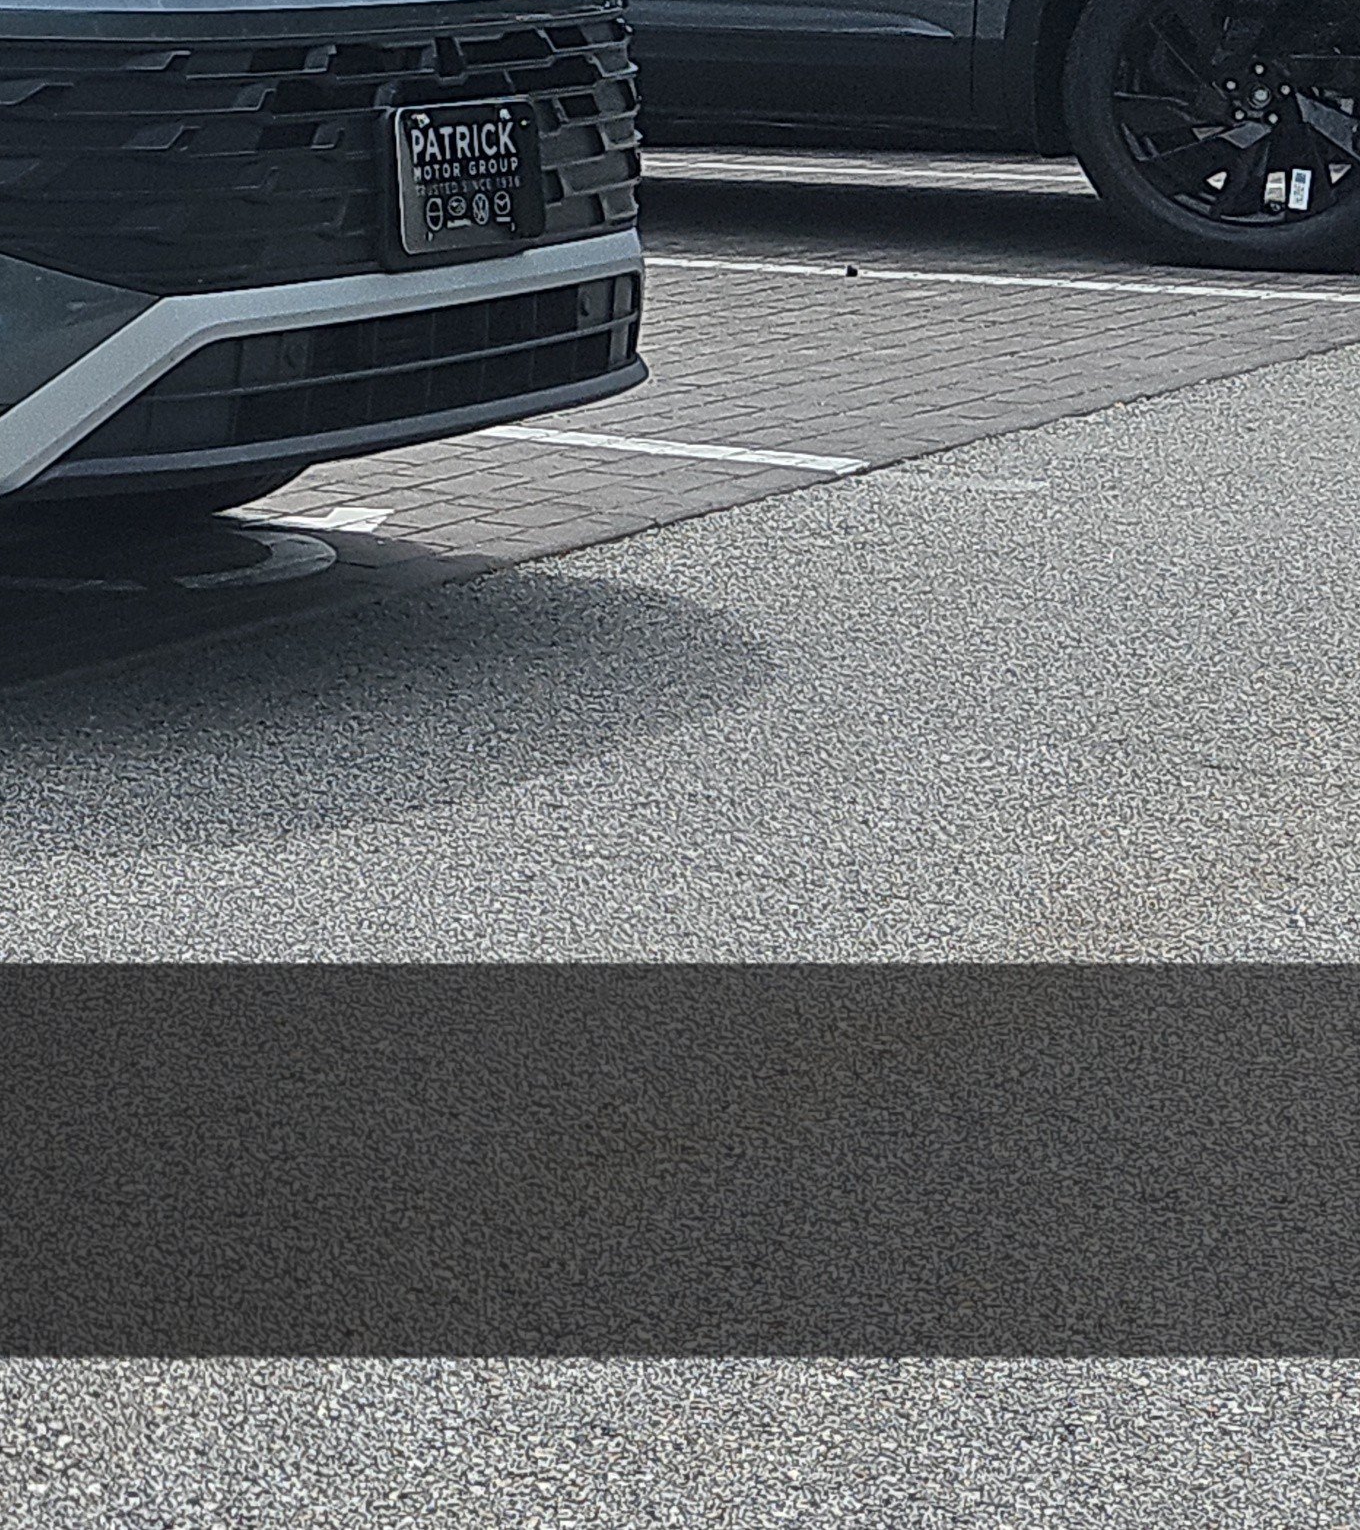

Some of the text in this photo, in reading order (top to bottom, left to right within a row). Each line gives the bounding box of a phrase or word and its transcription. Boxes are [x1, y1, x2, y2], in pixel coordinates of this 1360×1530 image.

[410, 121, 517, 164] PATRICK
[413, 156, 519, 182] MOTOR GROUP
[415, 181, 459, 196] TRSTED
[462, 178, 492, 193] SNCE
